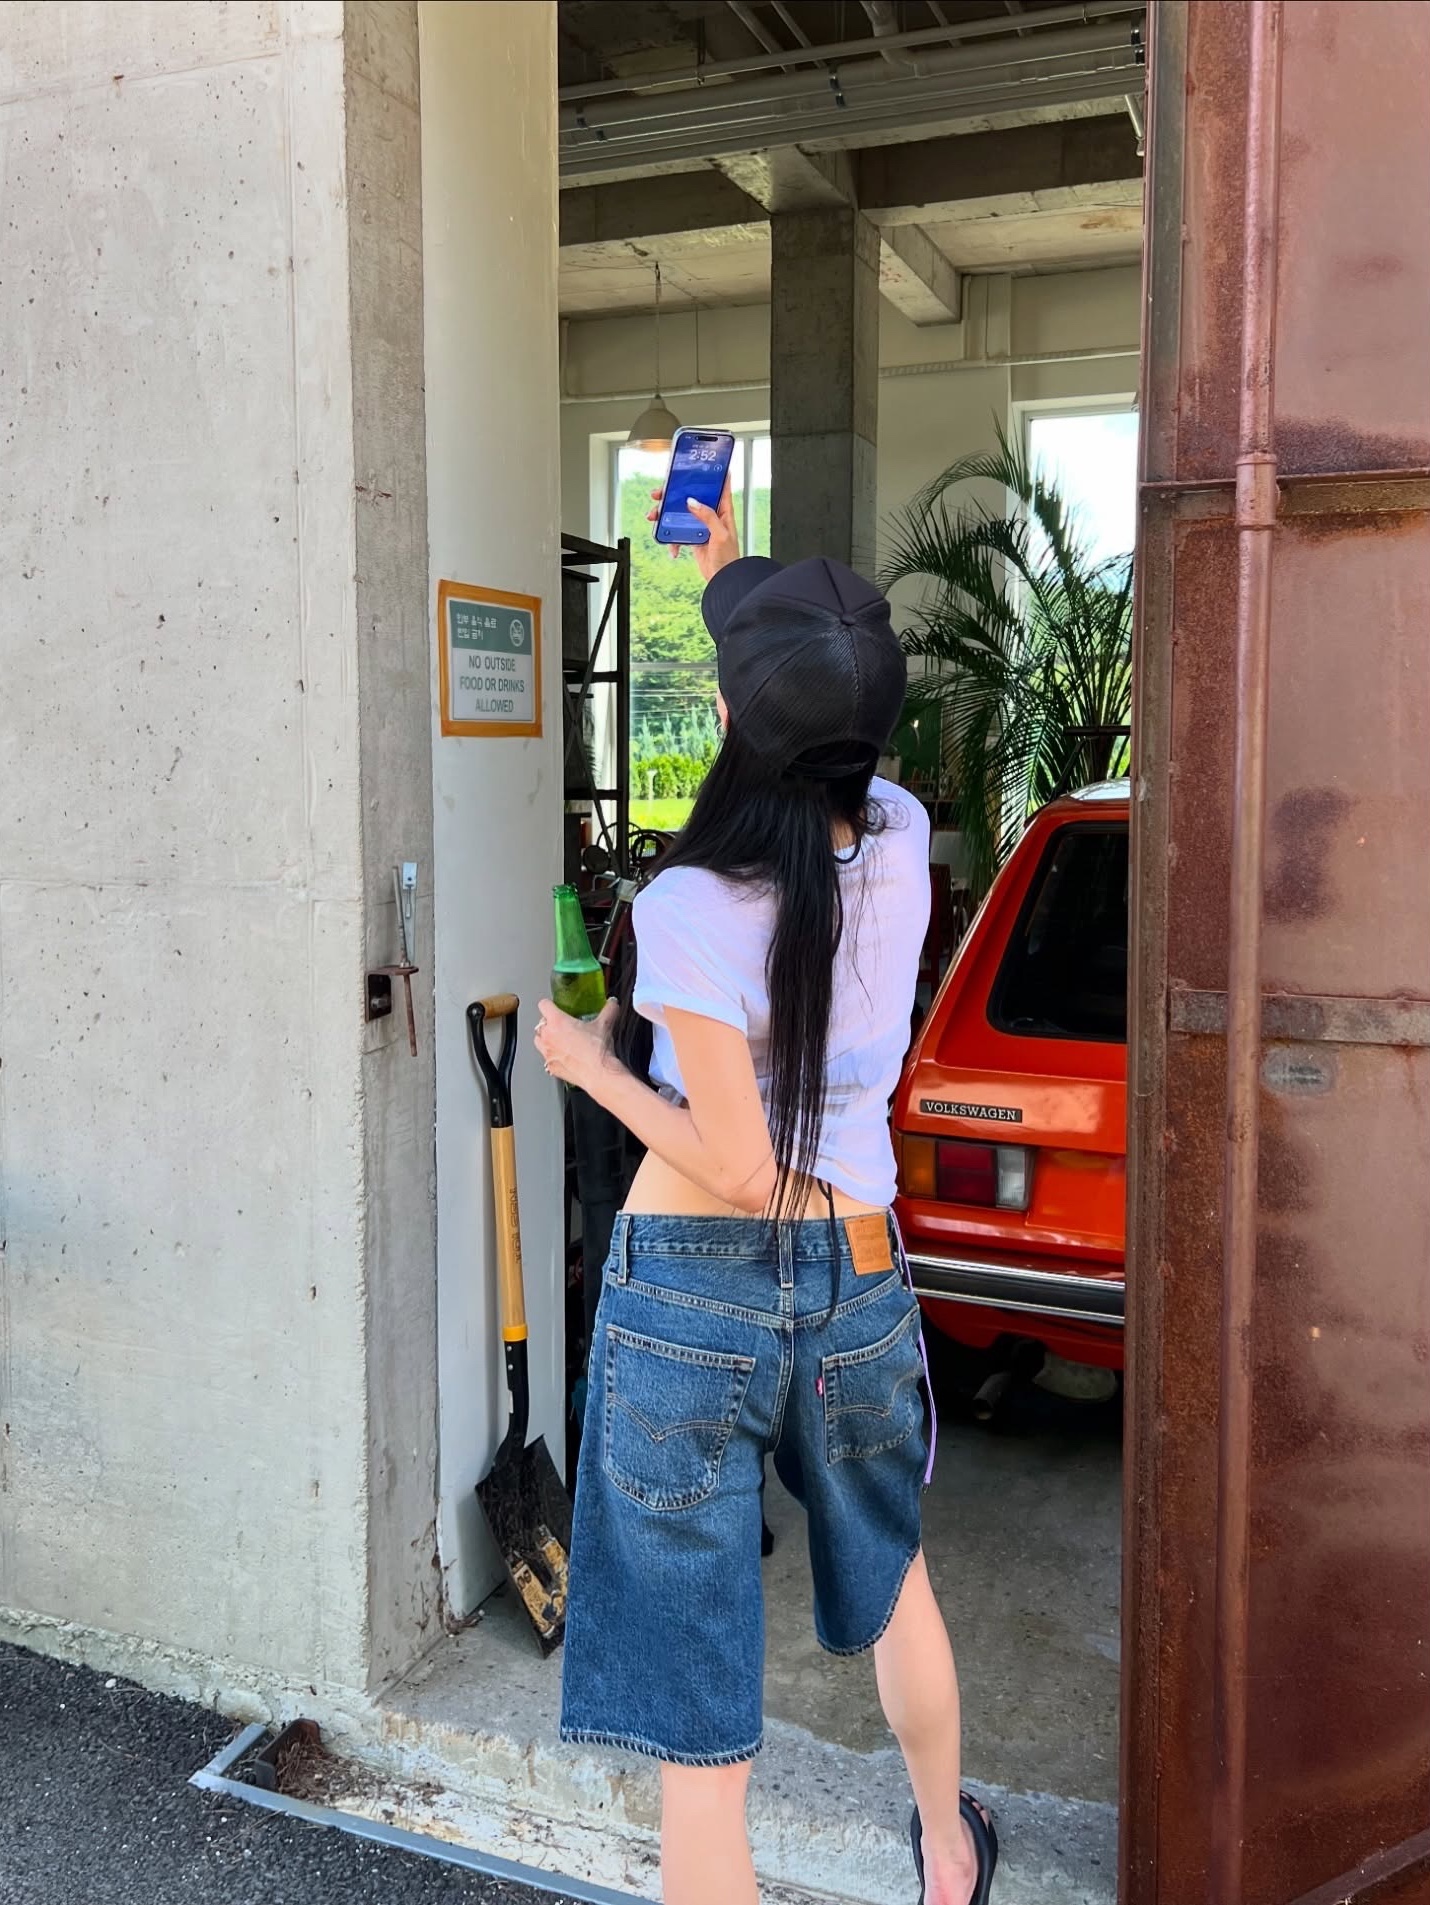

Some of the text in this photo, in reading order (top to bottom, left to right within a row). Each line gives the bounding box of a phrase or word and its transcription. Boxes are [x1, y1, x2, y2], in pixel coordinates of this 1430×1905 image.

[689, 449, 716, 461] 2:52
[469, 655, 516, 672] NO OUTSIDE
[459, 676, 525, 693] FOOD OR DRINKS
[475, 699, 514, 713] ALLOWED
[926, 1101, 1016, 1121] VOLKSWAGEN
